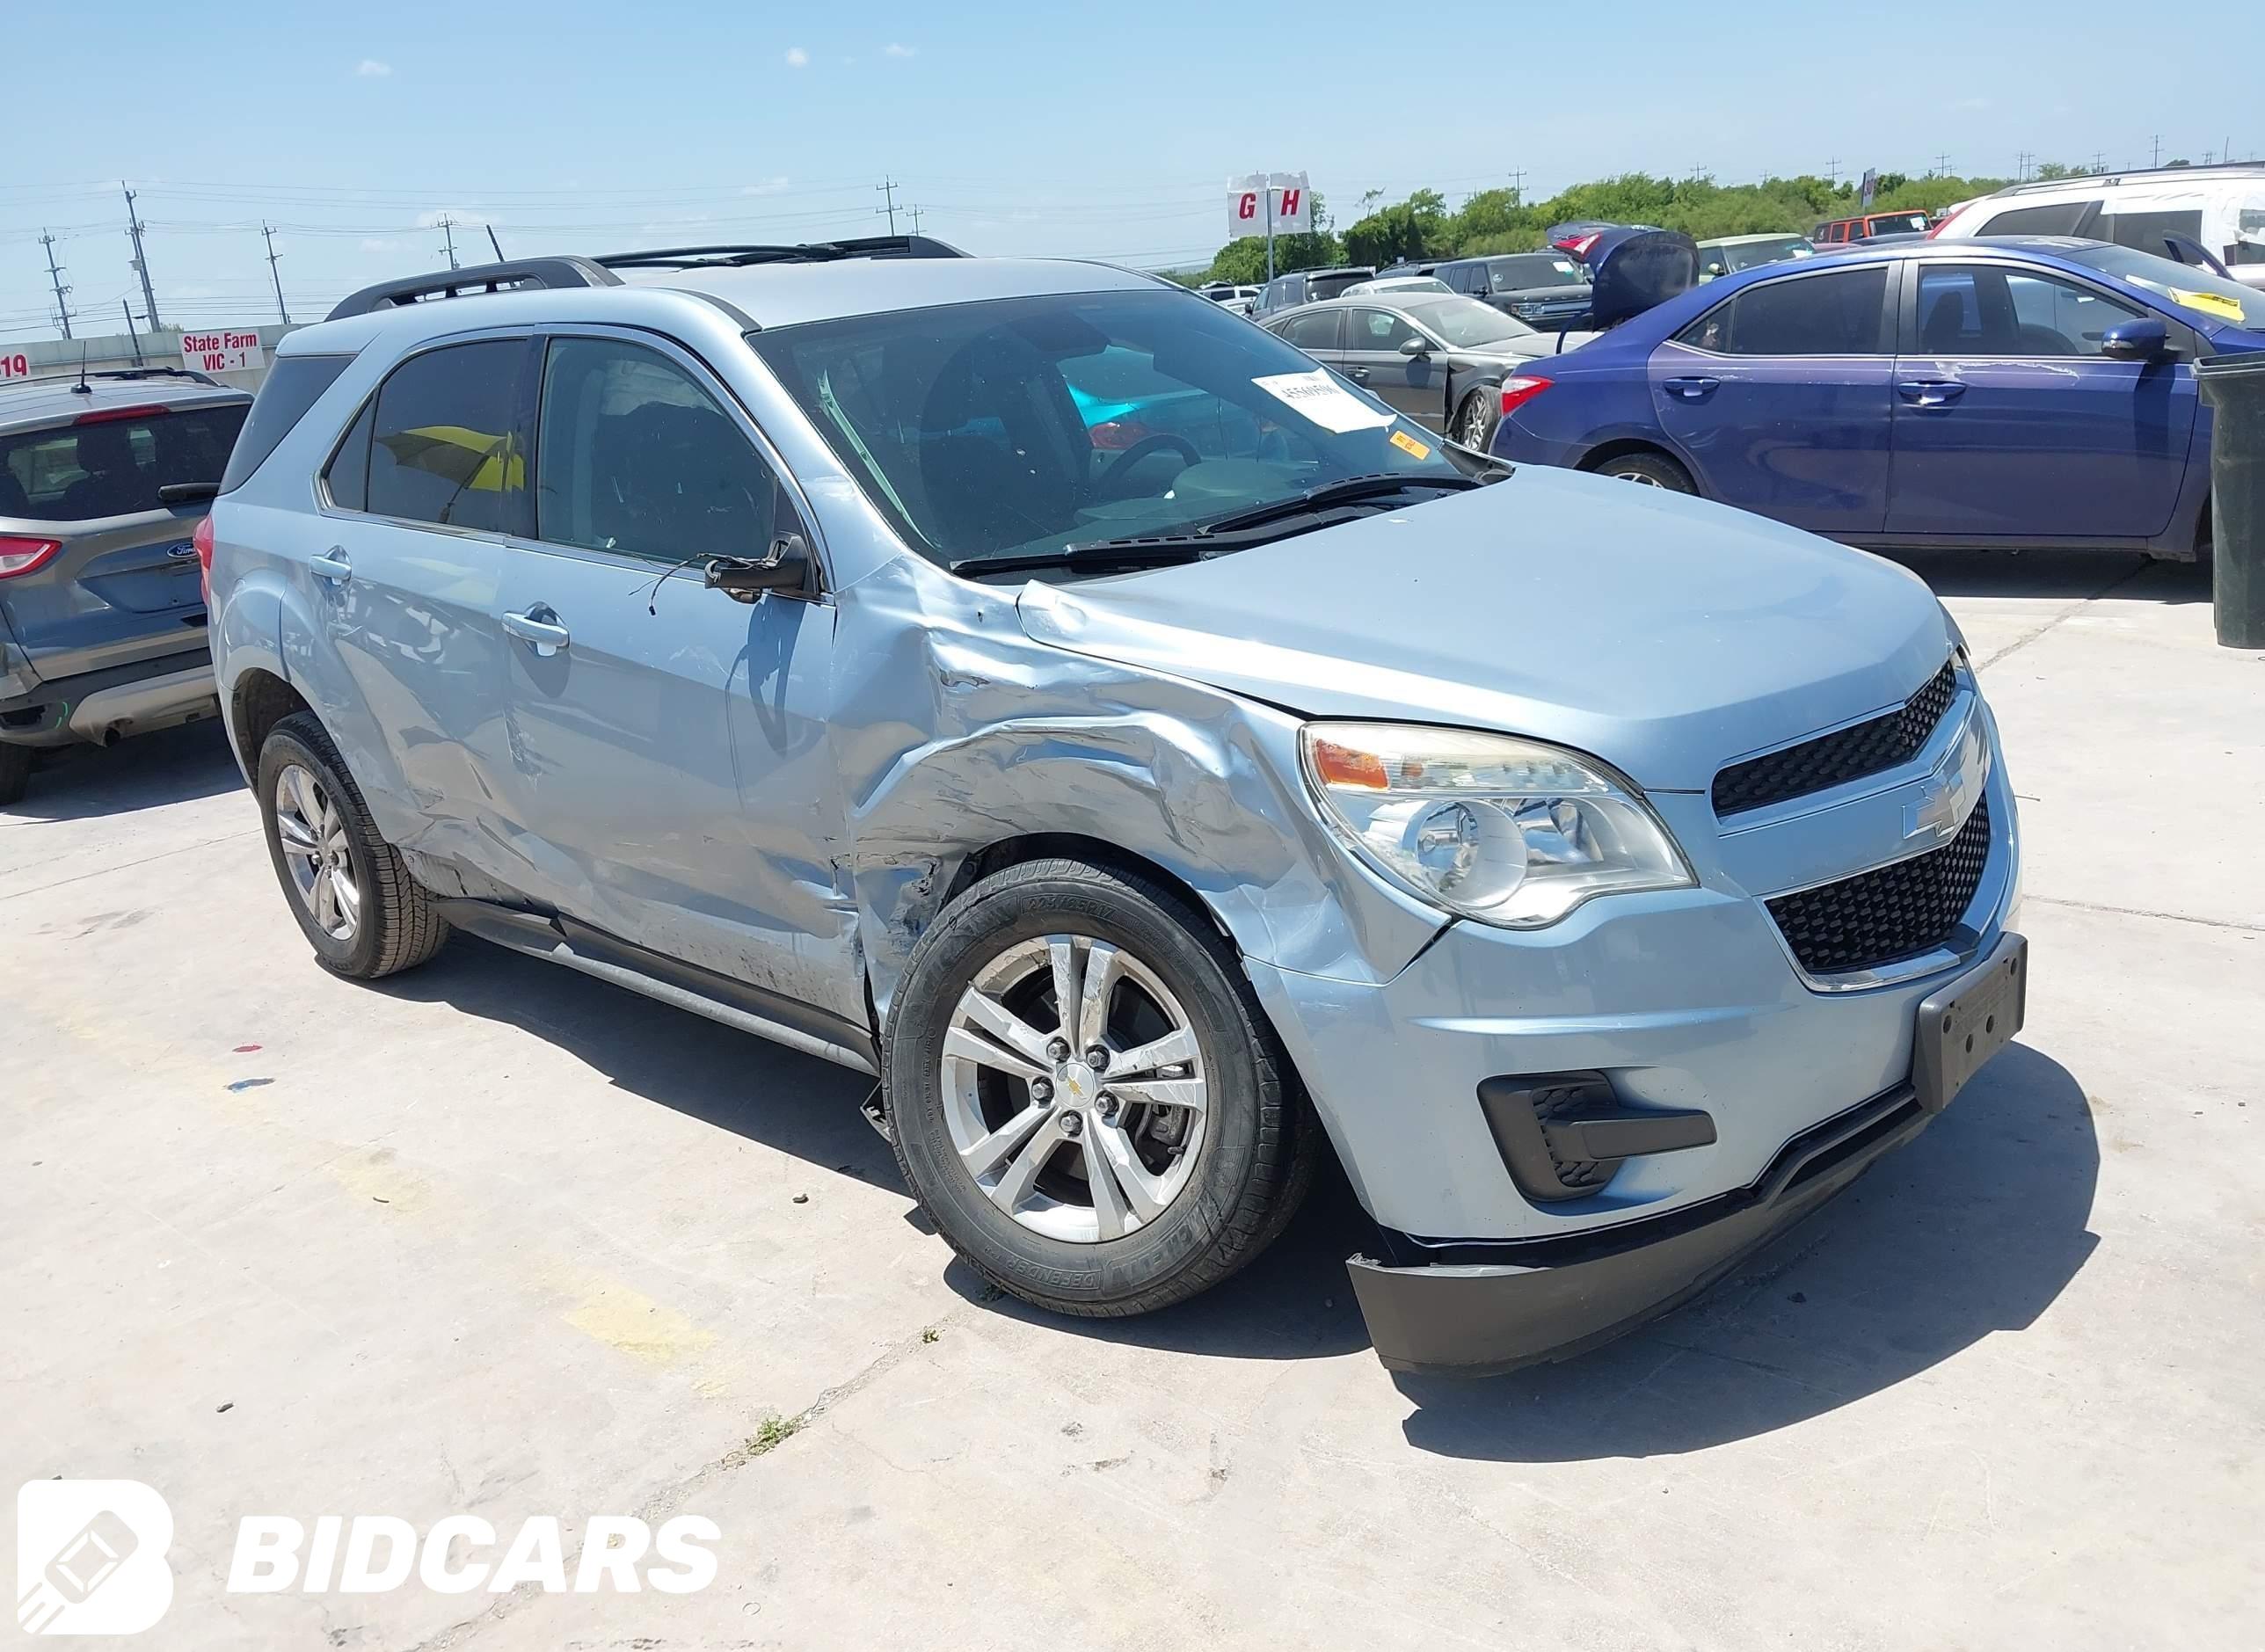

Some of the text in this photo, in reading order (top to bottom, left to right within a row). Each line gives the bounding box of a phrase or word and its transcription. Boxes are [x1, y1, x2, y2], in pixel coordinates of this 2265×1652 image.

[1239, 192, 1256, 220] G
[1280, 189, 1300, 216] H
[184, 331, 257, 353] State Farm
[203, 353, 225, 371] VIC
[238, 351, 245, 368] 1
[1006, 1257, 1096, 1288] DEFENDER
